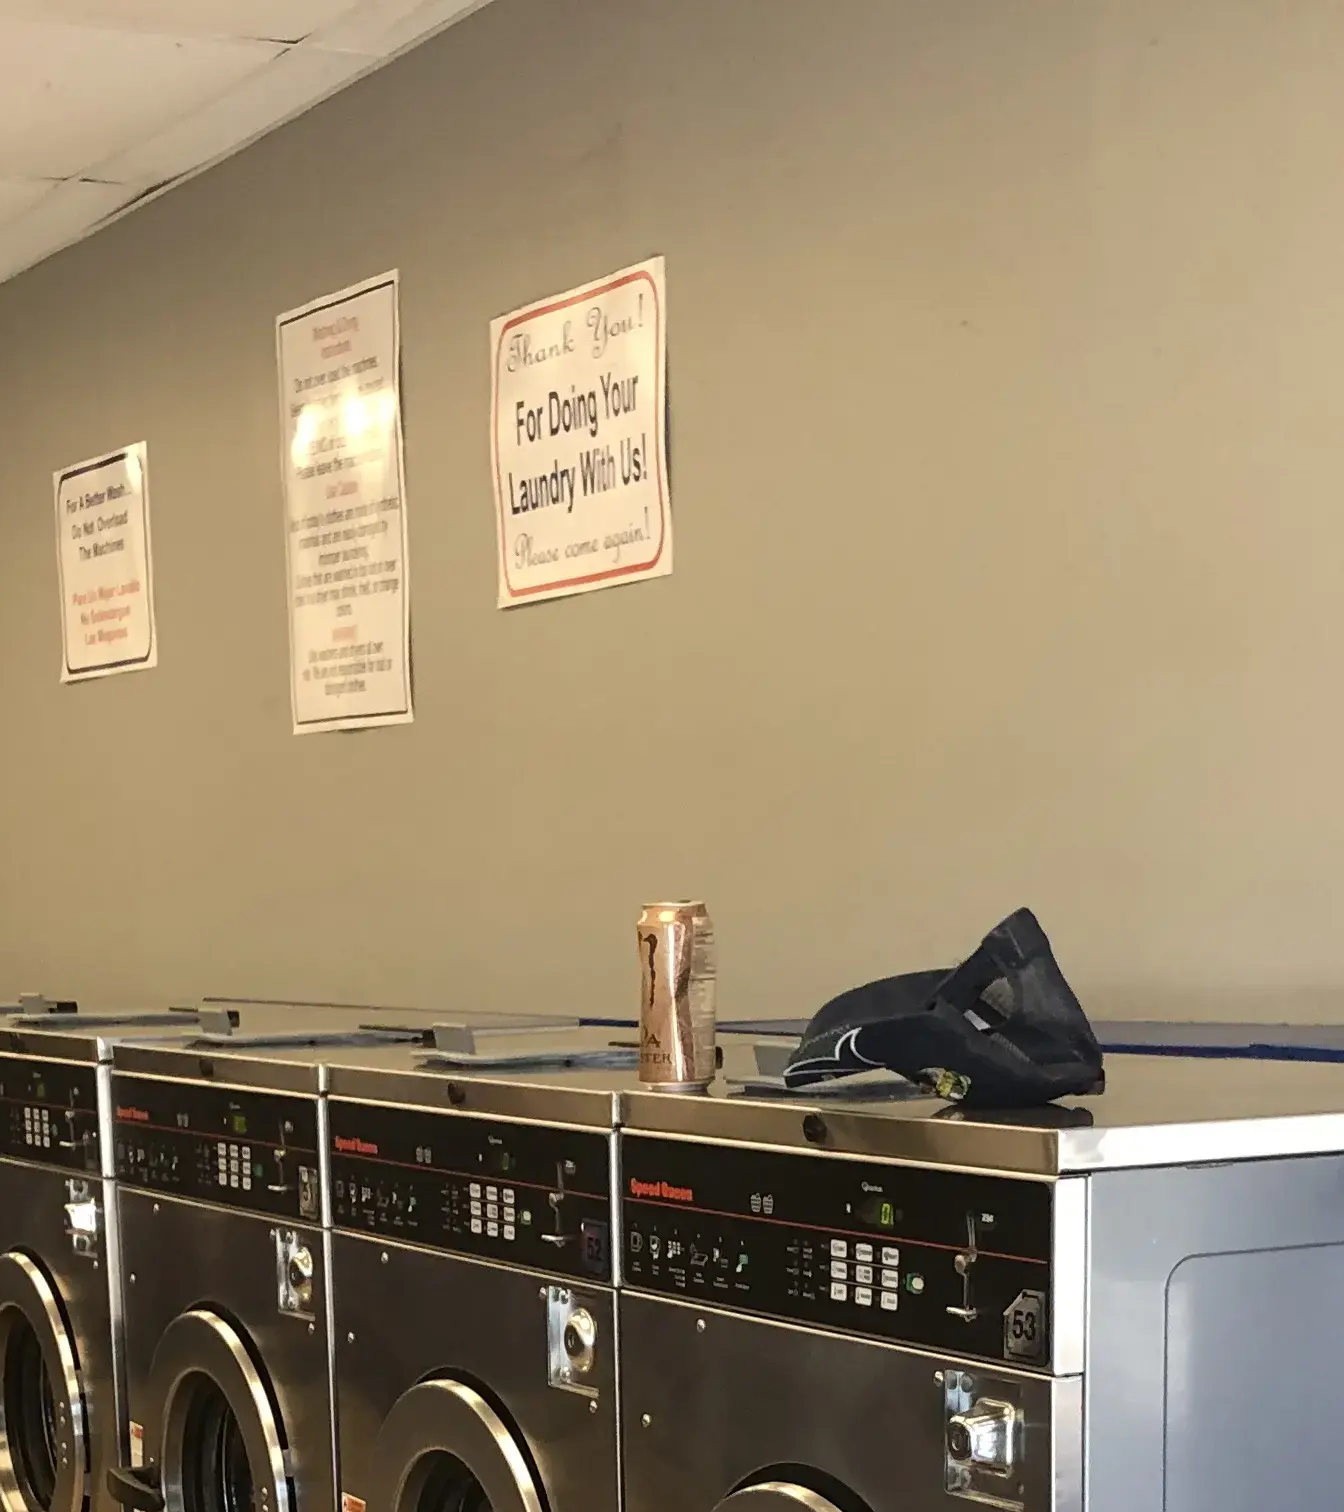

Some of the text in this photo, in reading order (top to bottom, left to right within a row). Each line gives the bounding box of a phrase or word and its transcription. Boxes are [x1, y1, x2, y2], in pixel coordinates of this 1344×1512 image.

[506, 293, 645, 373] Thank You!
[515, 372, 639, 446] For Doing Your
[508, 432, 648, 515] Laundry With Us!
[514, 506, 652, 570] Please come again!
[630, 1177, 661, 1198] Speed
[1012, 1310, 1037, 1341] 53
